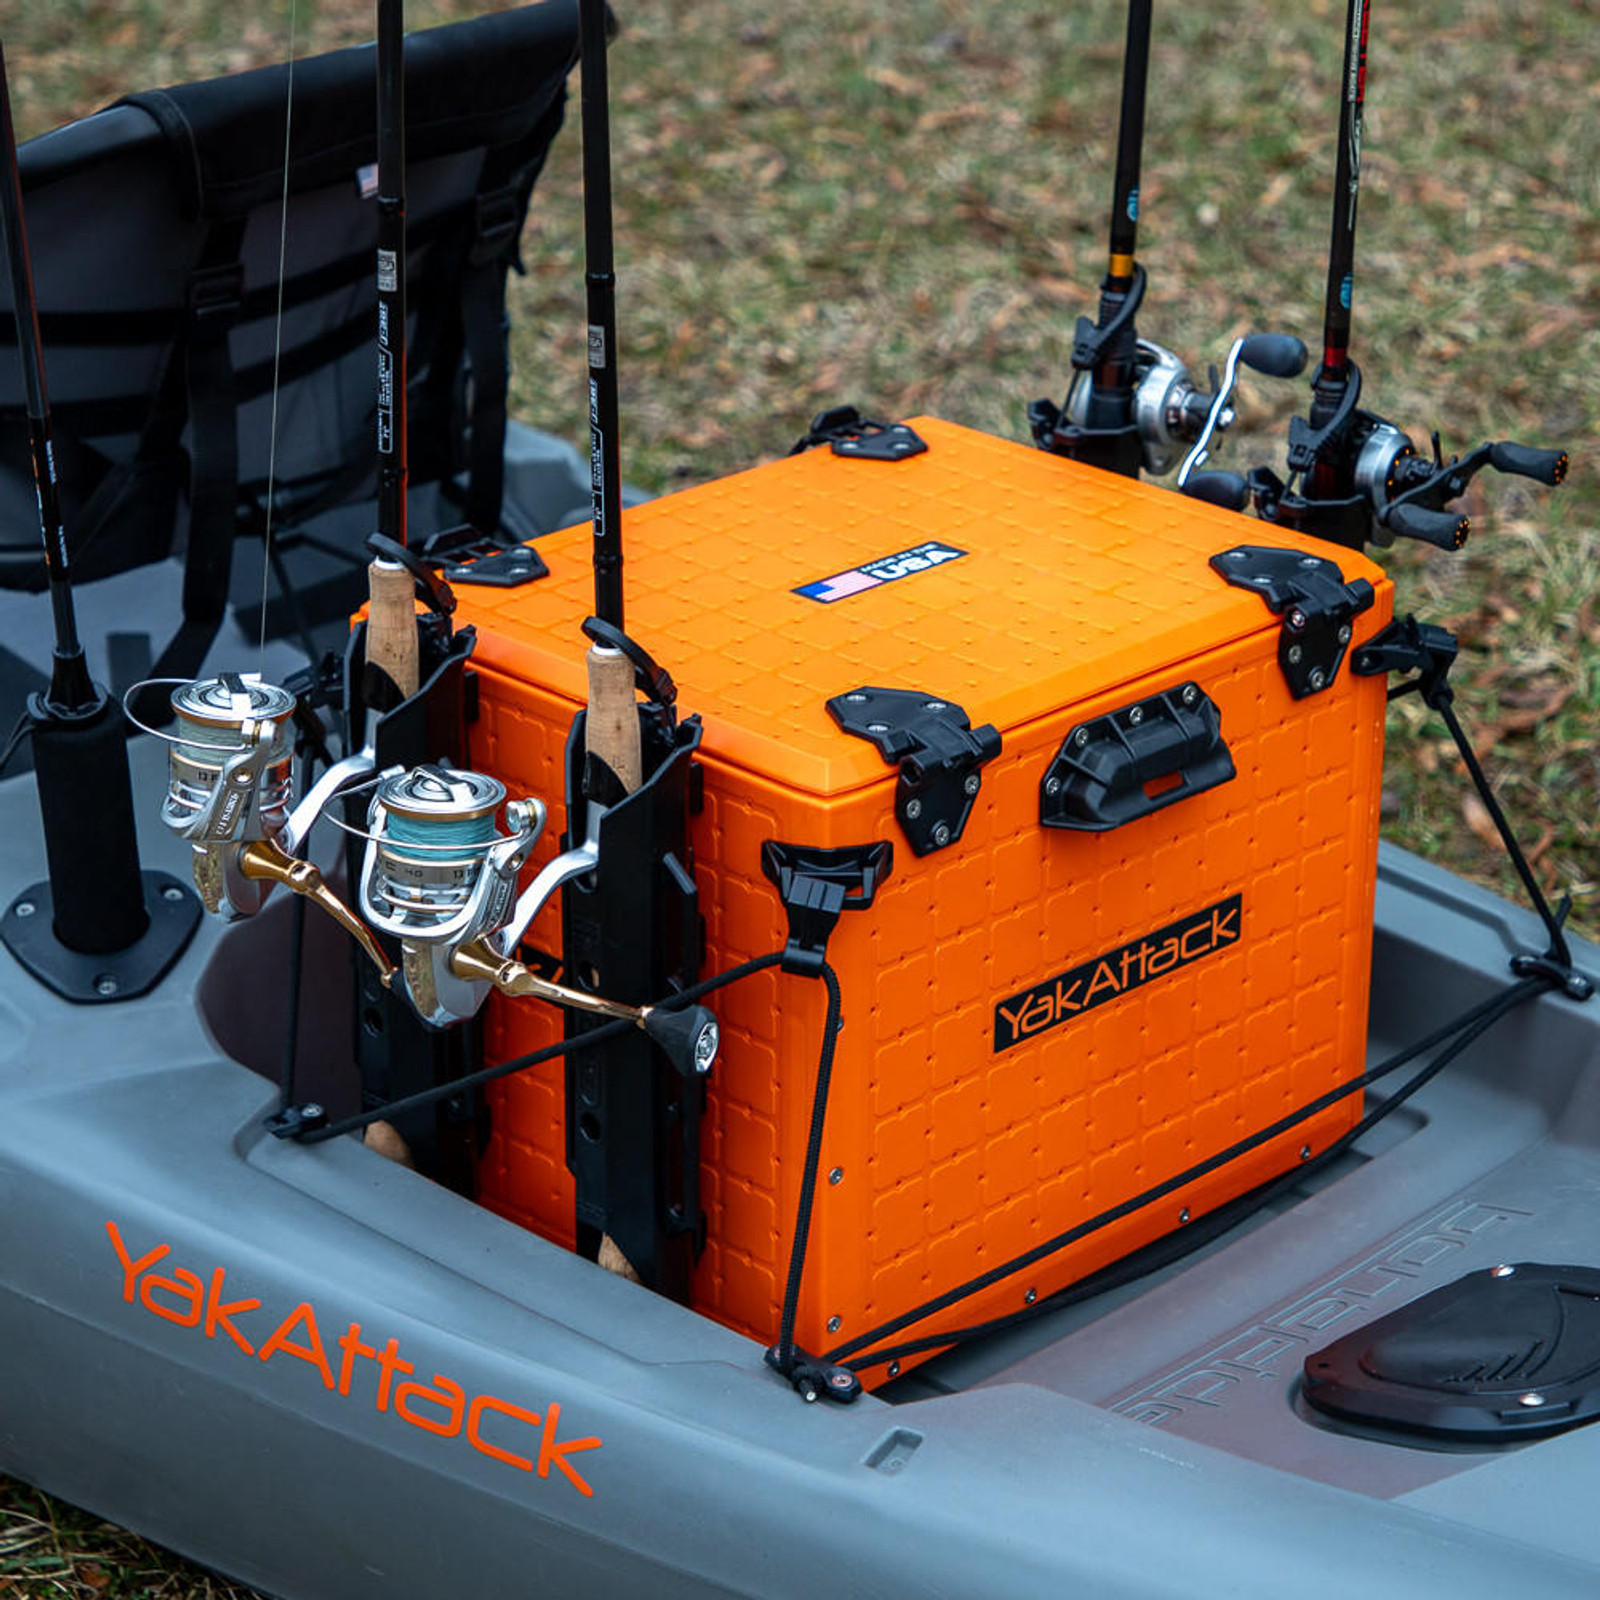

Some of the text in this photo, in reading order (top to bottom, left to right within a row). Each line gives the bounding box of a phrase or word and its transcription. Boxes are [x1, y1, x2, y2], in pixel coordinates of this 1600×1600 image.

[869, 550, 960, 580] USA
[998, 907, 1238, 1040] YakAttack
[105, 1219, 604, 1499] YakAttack
